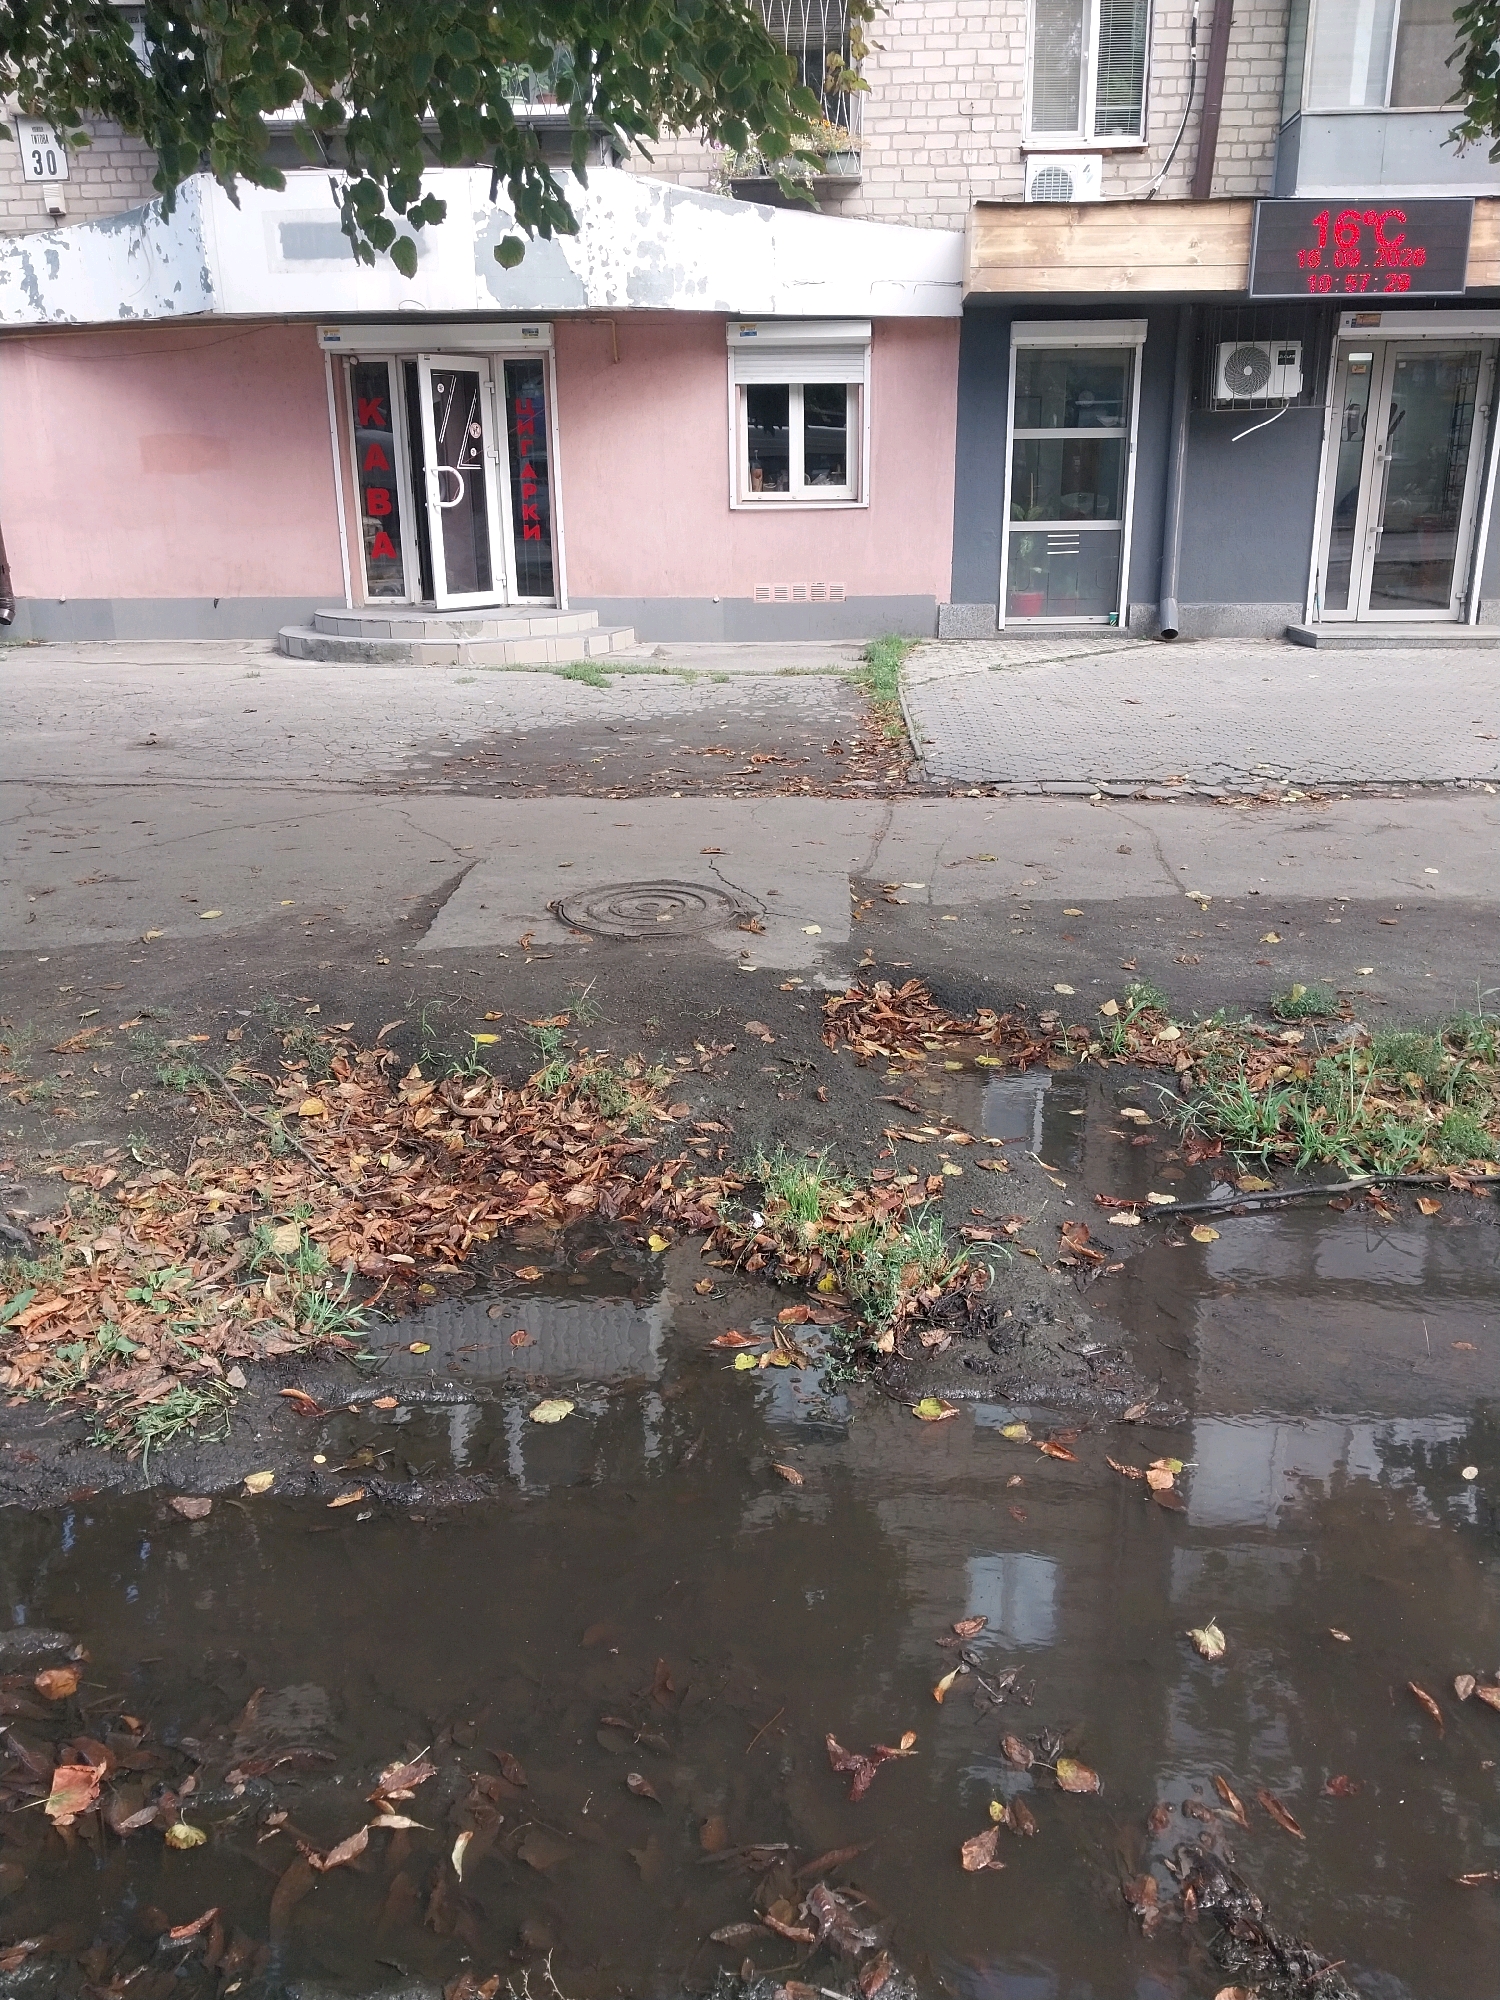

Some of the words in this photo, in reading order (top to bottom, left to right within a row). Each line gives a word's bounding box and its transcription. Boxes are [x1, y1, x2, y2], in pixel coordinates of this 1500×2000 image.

[31, 149, 57, 175] 30
[357, 397, 397, 559] КАВА
[515, 397, 541, 541] ЦИГАРКИ
